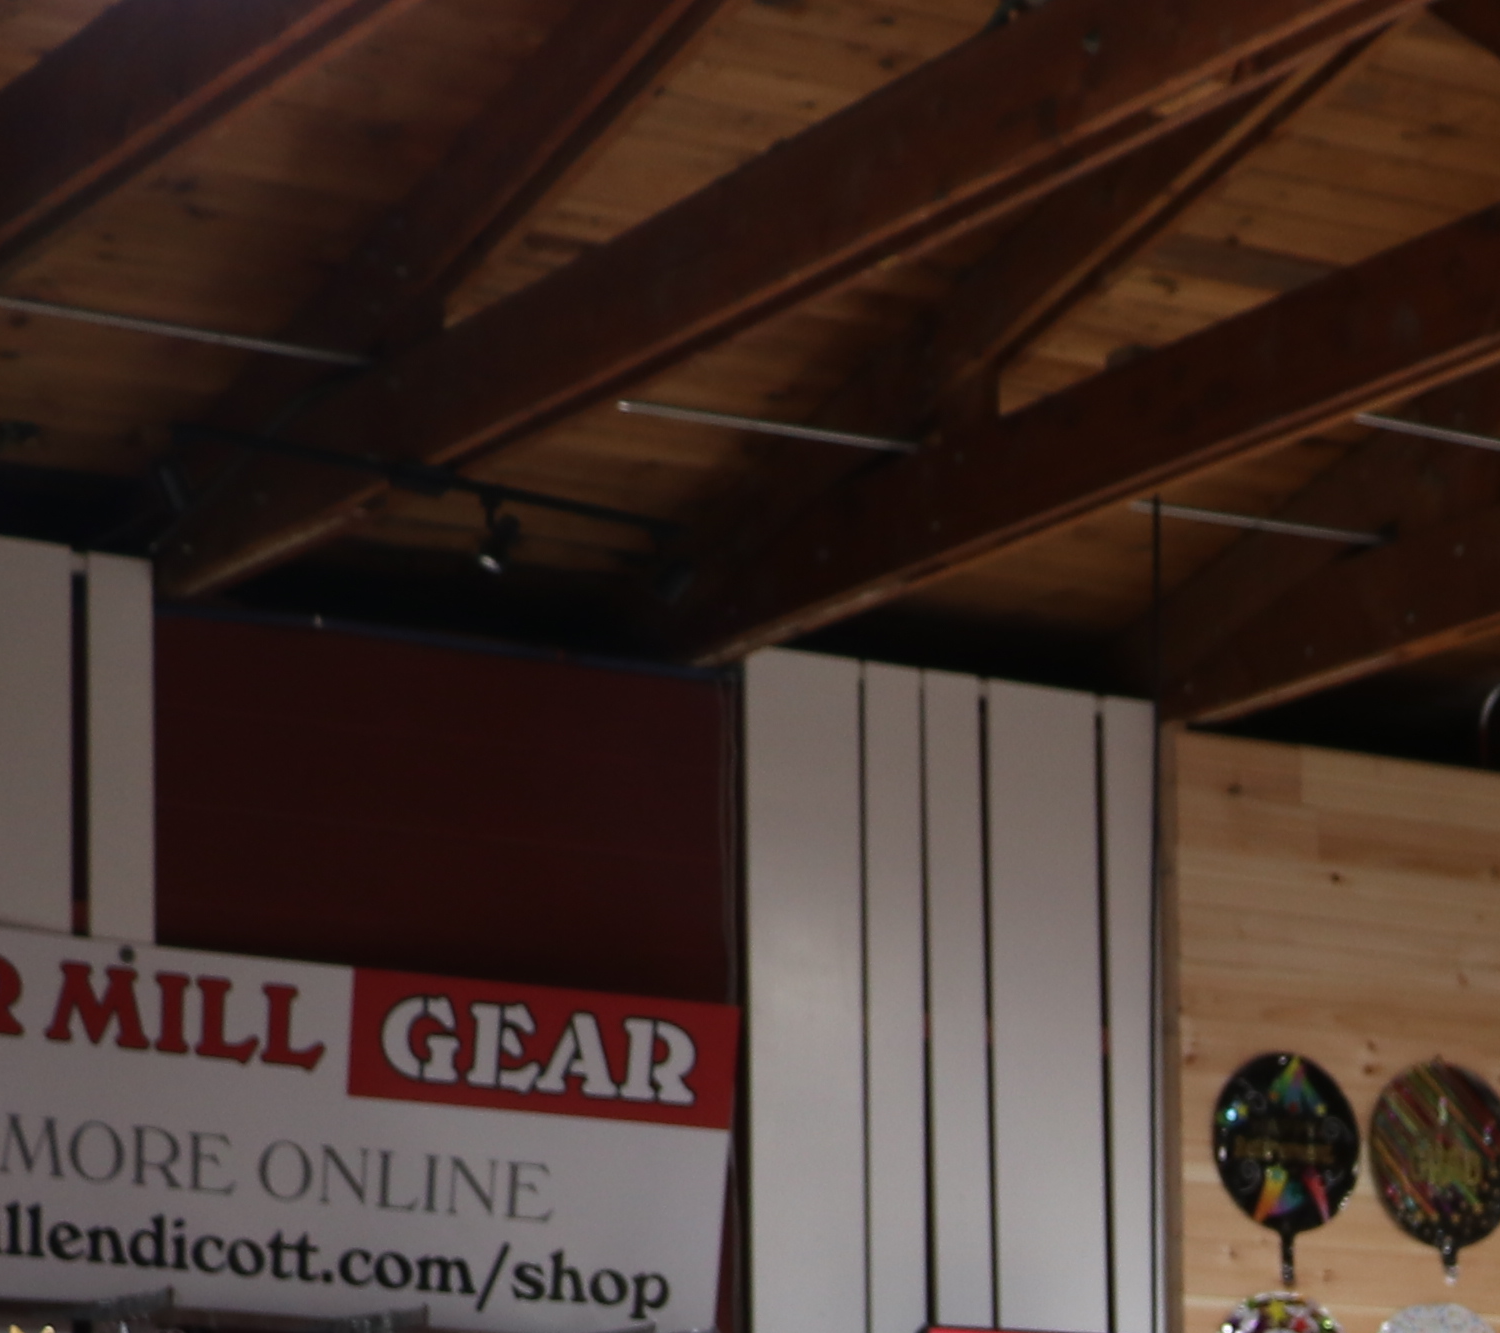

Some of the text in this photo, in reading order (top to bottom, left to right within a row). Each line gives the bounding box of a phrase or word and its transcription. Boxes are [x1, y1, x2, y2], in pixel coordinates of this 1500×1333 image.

[45, 960, 326, 1073] MILL
[379, 992, 699, 1107] GEAR
[258, 1139, 555, 1225] ONLINE
